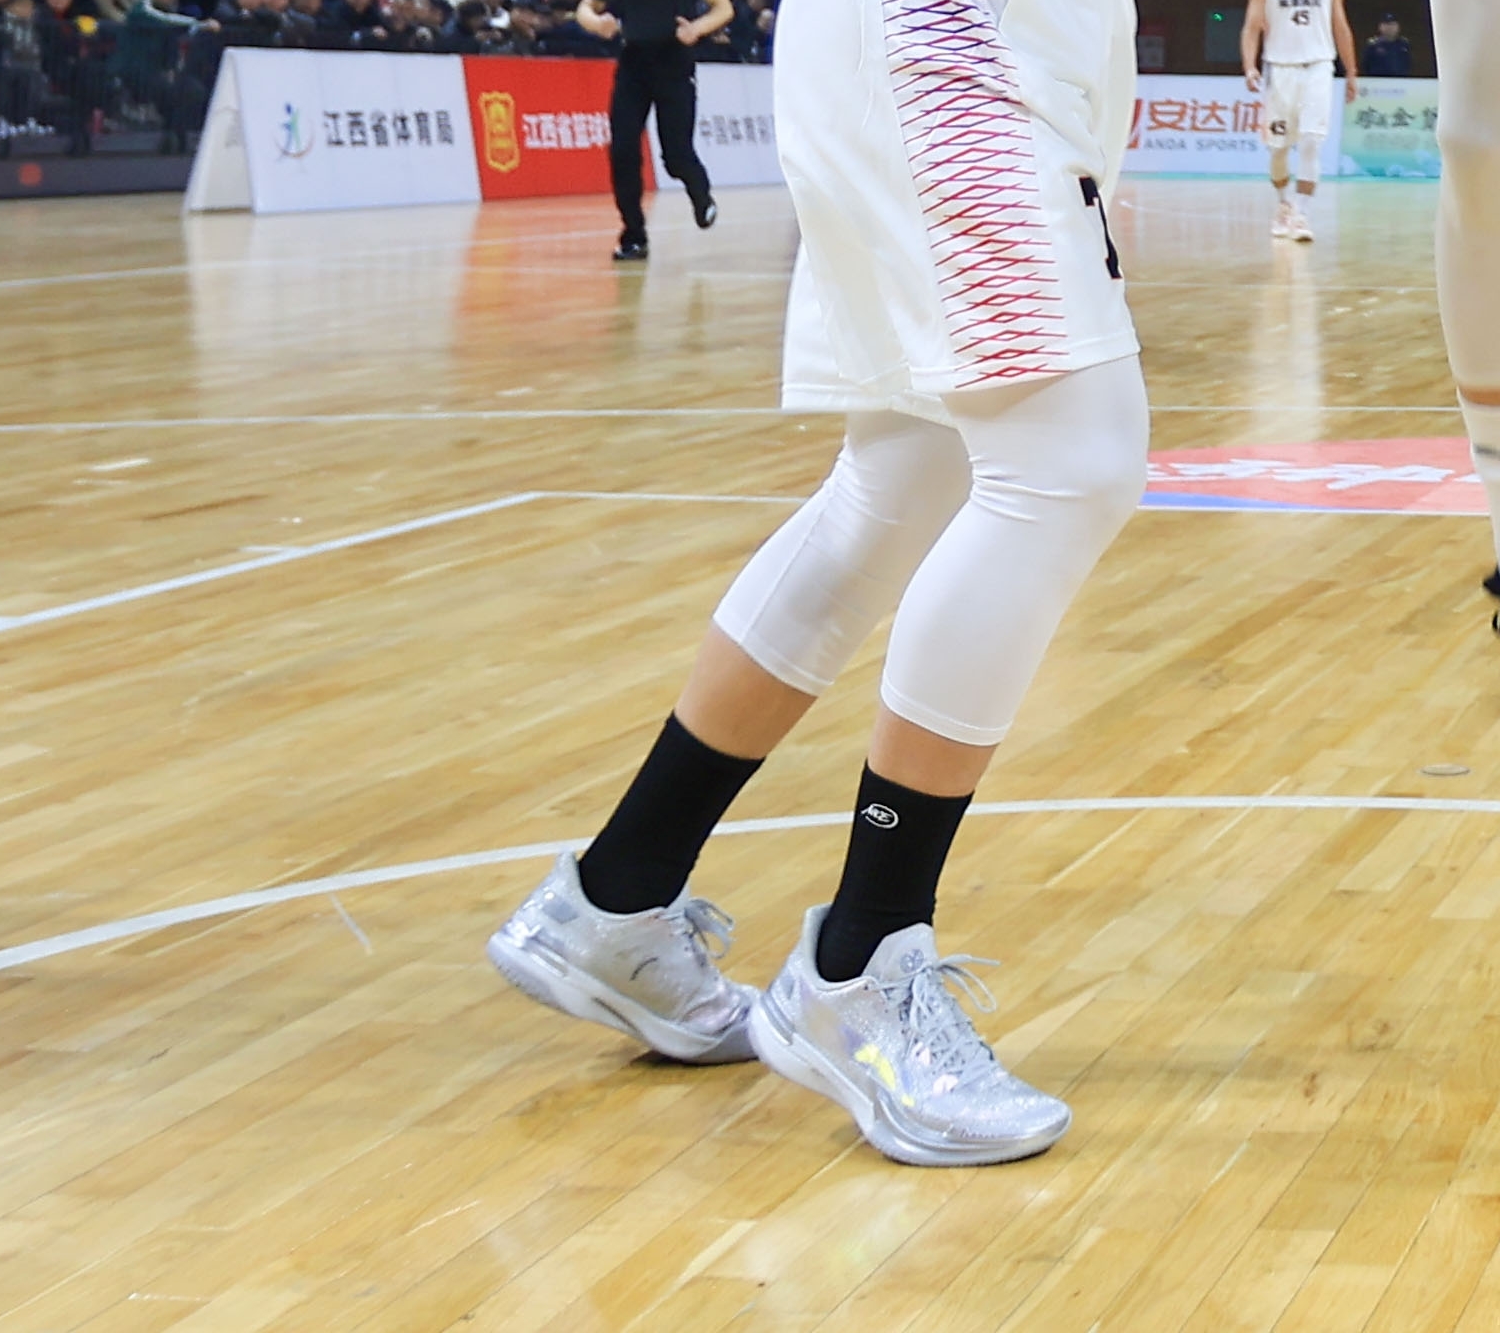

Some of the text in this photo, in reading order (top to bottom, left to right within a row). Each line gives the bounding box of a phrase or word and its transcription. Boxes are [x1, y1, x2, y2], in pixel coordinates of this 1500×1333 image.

[323, 109, 455, 149] 江西省体育局
[1196, 139, 1258, 152] SPORTS
